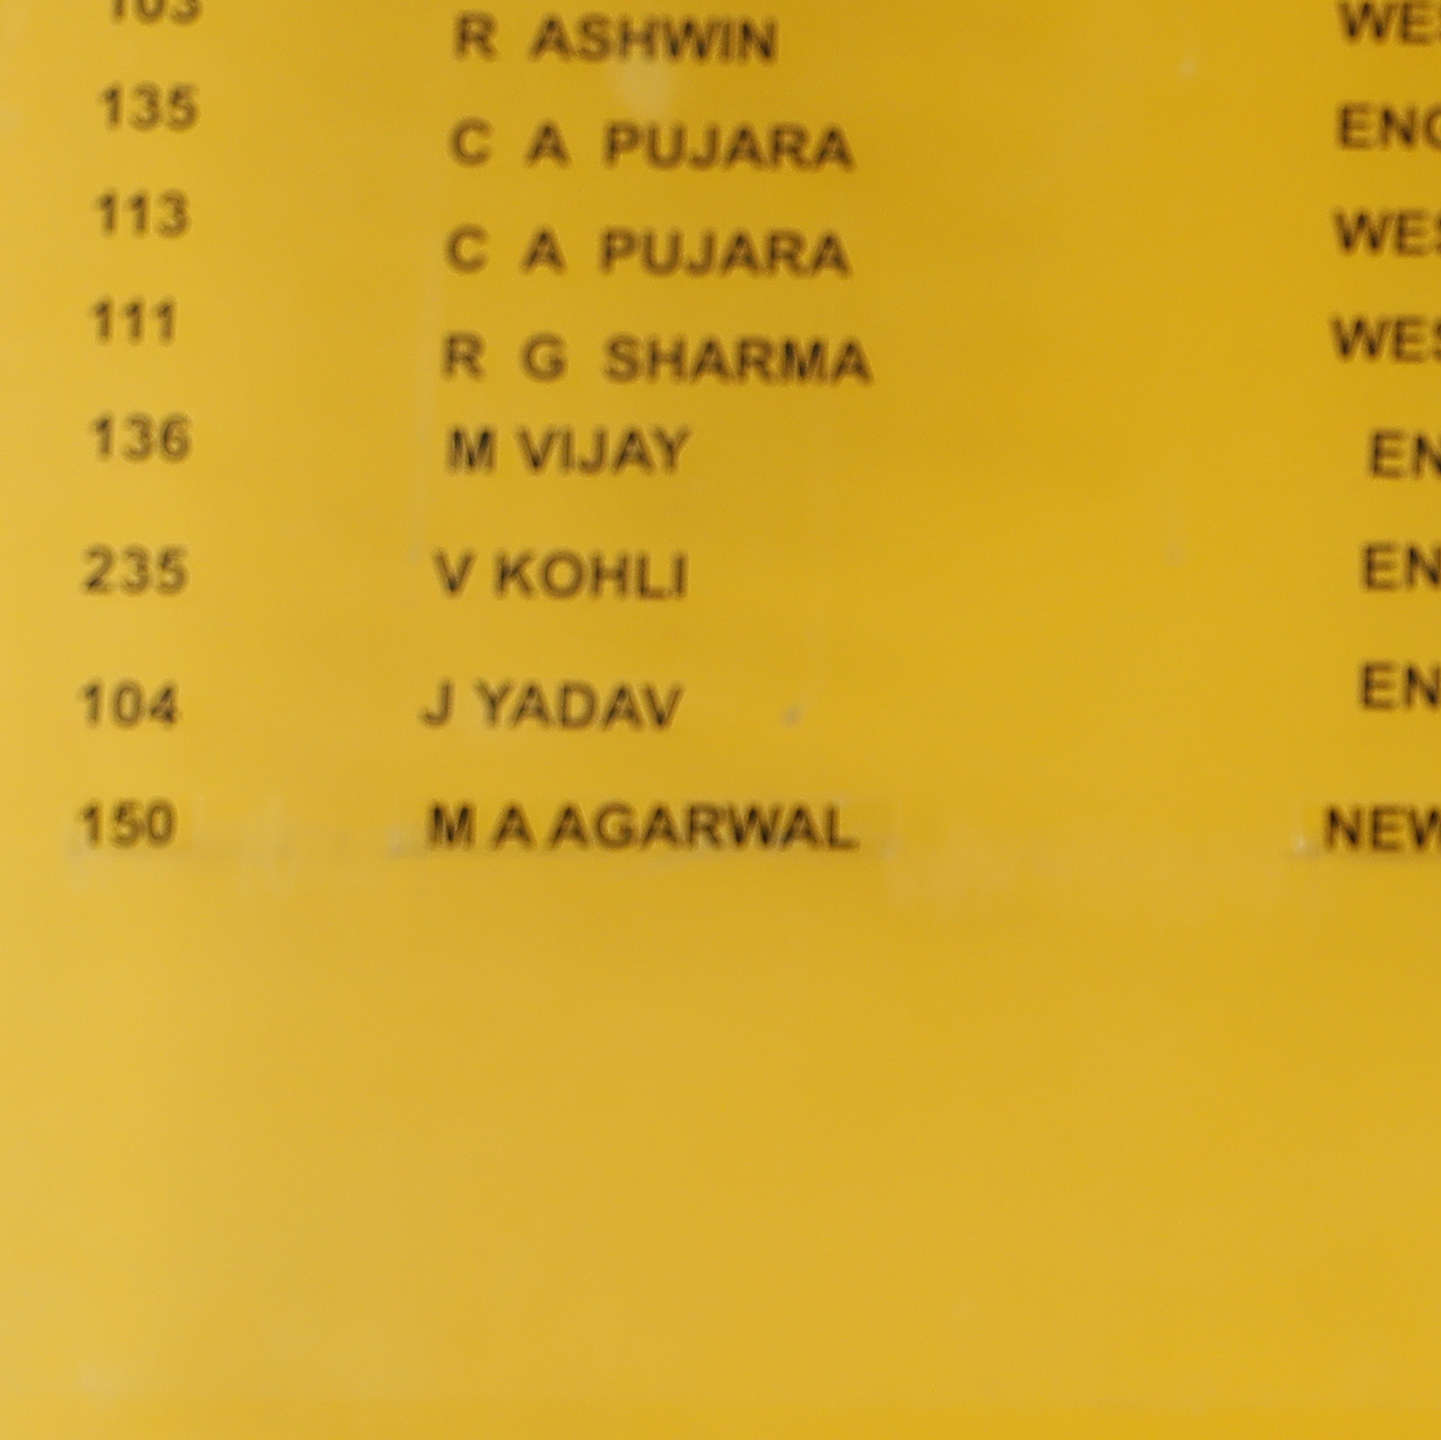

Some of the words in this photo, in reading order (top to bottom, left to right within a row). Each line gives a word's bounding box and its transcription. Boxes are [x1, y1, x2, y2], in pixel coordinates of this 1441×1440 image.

[453, 11, 497, 60] R
[529, 14, 778, 64] ASHWIN
[100, 82, 199, 132] 135
[448, 117, 491, 167] C
[525, 121, 570, 166] A
[604, 121, 855, 172] PUJARA
[95, 189, 190, 239] 113
[443, 224, 487, 275] C
[520, 227, 565, 272] A
[600, 228, 851, 277] PUJARA
[90, 298, 176, 343] 111
[440, 331, 484, 380] R
[520, 333, 567, 383] G
[604, 334, 874, 385] SHARMA
[90, 412, 192, 463] 136
[446, 425, 498, 475] M
[514, 425, 692, 475] VIJAY
[81, 543, 188, 596] 235
[433, 548, 476, 598] V
[493, 549, 688, 601] KOHLI
[82, 679, 180, 729] 104
[421, 680, 454, 728] J
[475, 681, 684, 732] YADAV
[78, 798, 178, 851] 150
[425, 800, 477, 852] M
[546, 801, 862, 854] AGARWAL
